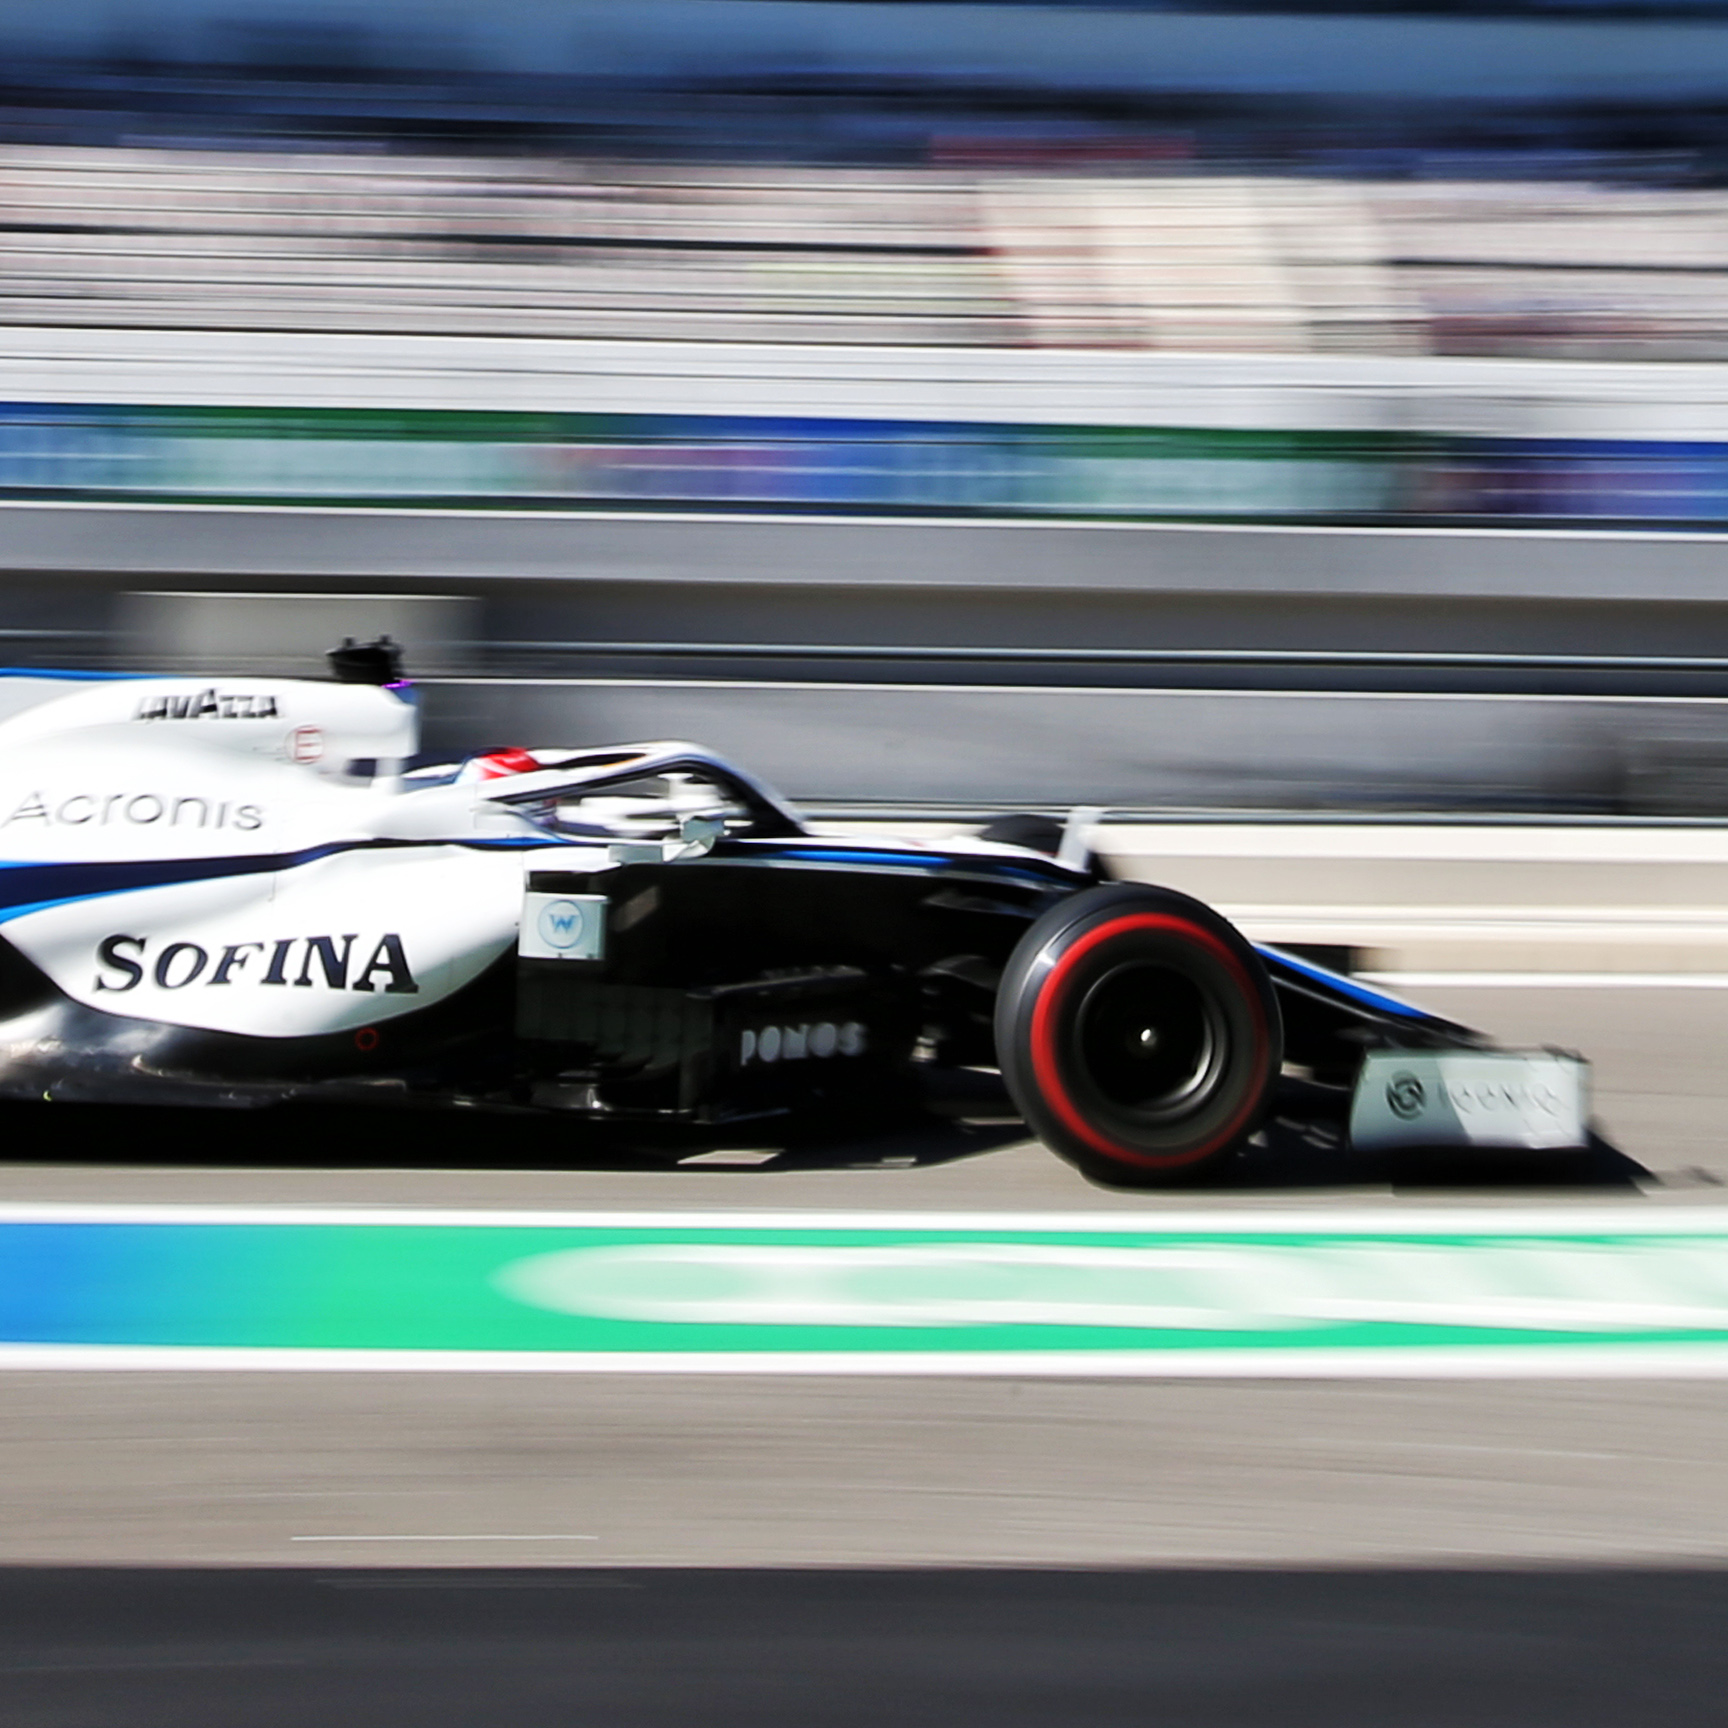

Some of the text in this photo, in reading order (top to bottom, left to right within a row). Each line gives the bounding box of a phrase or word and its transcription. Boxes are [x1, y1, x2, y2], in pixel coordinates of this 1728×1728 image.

[0, 791, 264, 831] Acronis
[92, 934, 419, 994] SOFINA
[740, 1021, 869, 1066] PONOS
